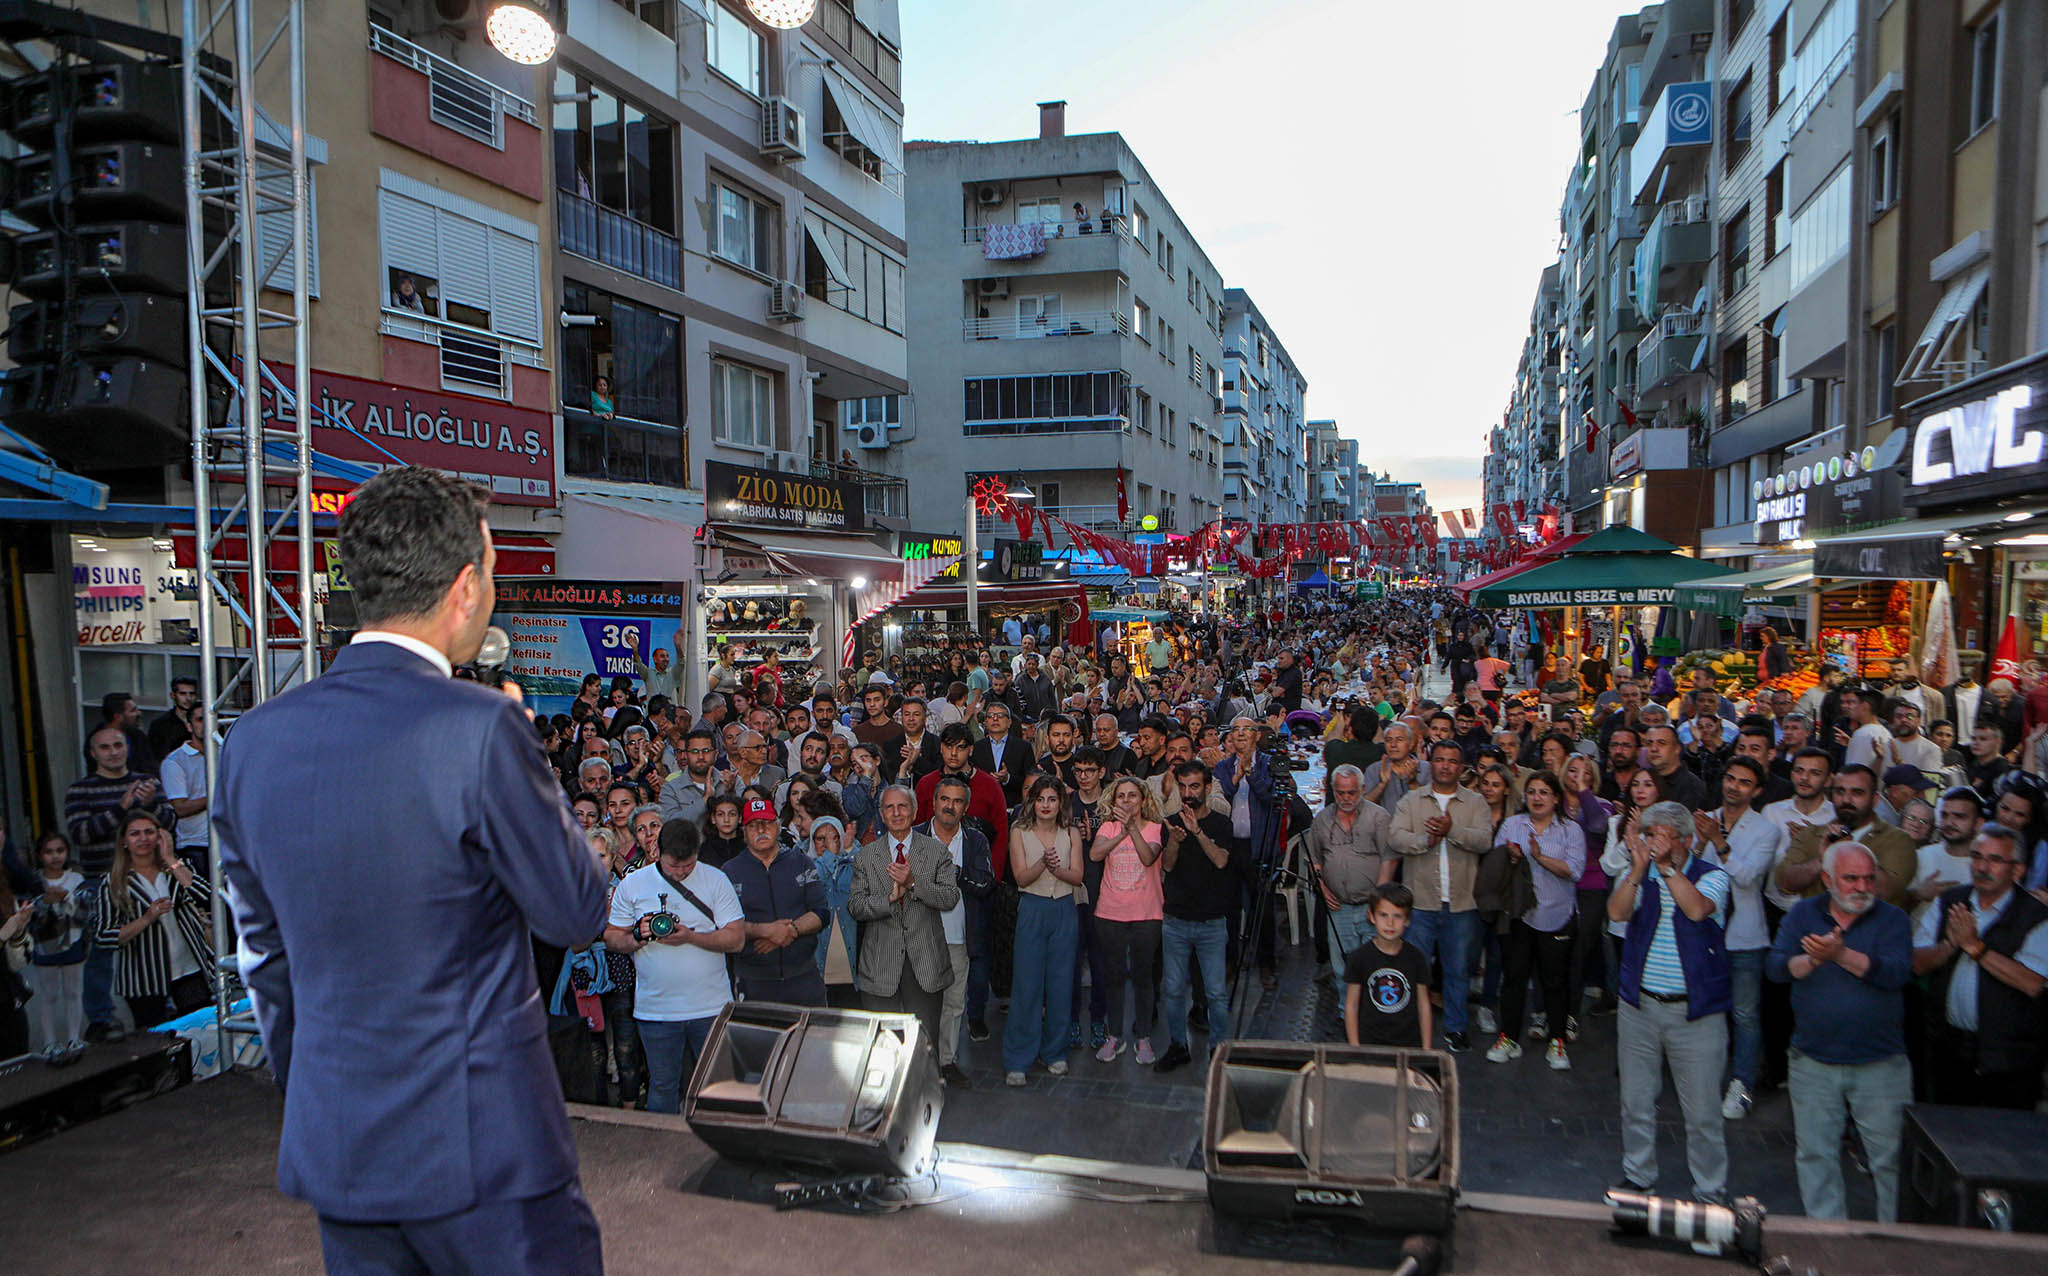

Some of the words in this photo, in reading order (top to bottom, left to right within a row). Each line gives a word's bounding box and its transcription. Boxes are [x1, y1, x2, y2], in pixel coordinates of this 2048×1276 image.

[362, 400, 492, 450] ALİOĞLU
[496, 424, 549, 465] A.Ş.
[737, 471, 778, 503] ZİO
[783, 481, 845, 511] MODA
[737, 503, 778, 520] FABRİKA
[779, 508, 803, 525] SATIŞ
[805, 509, 845, 526] MAĞAZASI
[932, 539, 961, 556] KUMRU
[533, 584, 595, 604] ALİOĞLU
[597, 589, 625, 607] A.Ş.
[627, 593, 648, 605] 345
[650, 594, 664, 606] 44
[667, 594, 681, 606] 42
[1508, 590, 1571, 605] BAYRAKLI
[1574, 590, 1617, 603] SEBZE
[1619, 592, 1635, 602] ve
[512, 616, 568, 628] Peşinatsız
[512, 632, 558, 644] Senetsiz
[602, 624, 640, 649] 36
[512, 648, 552, 660] Kefilsiz
[512, 665, 540, 676] Kredi
[543, 666, 582, 678] Kartsız
[606, 654, 638, 675] TAKSİ
